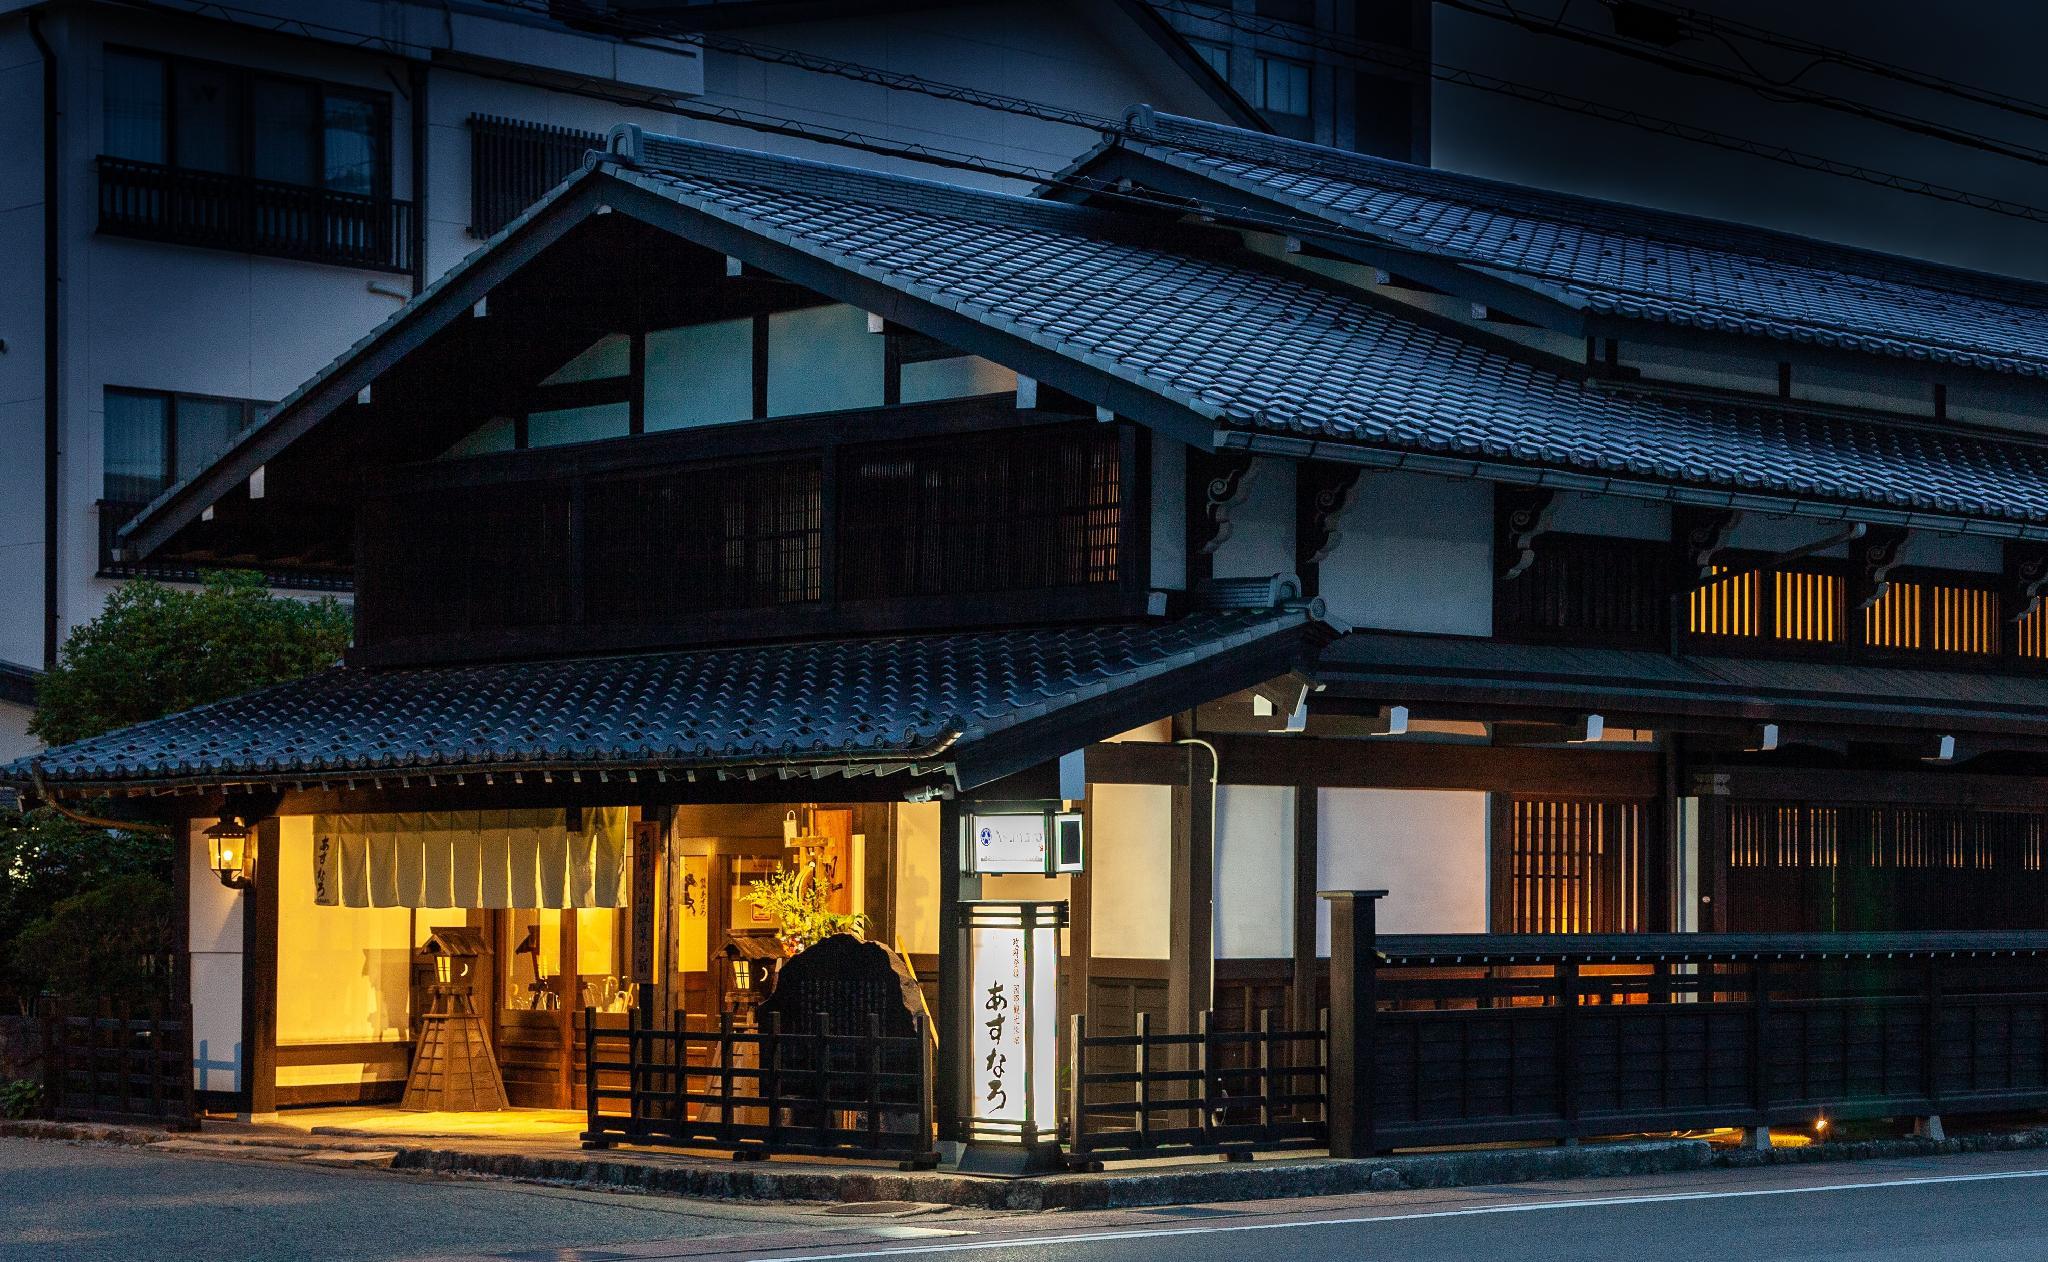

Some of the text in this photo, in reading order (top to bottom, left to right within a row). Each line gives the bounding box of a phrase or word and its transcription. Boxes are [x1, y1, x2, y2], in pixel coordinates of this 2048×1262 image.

[318, 835, 330, 897] あすなろ
[985, 980, 1008, 1114] あすなろ
